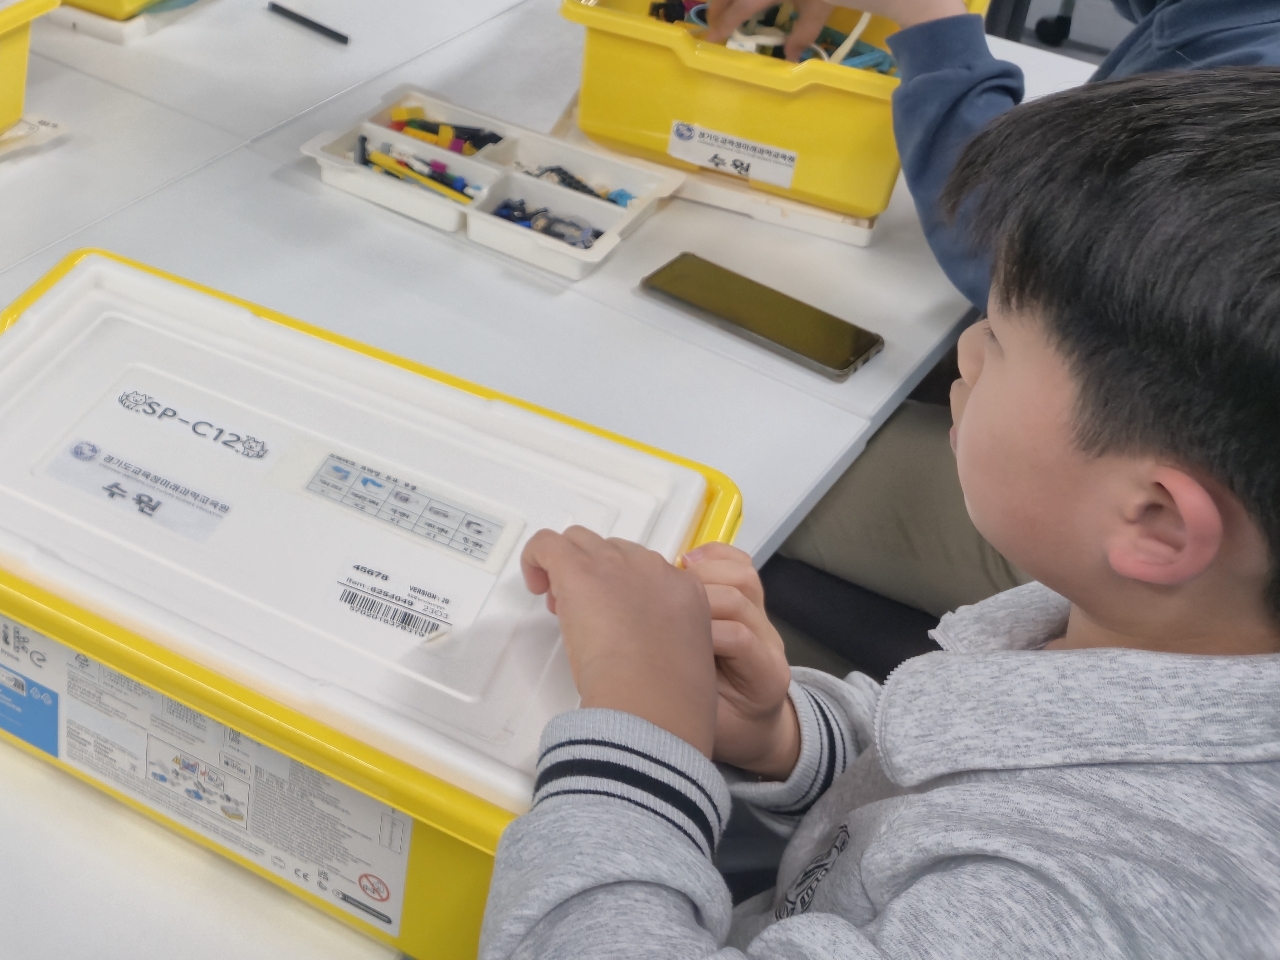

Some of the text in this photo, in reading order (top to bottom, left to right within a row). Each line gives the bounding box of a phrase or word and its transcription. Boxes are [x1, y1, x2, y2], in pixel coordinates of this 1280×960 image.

[142, 401, 241, 450] SP-C12
[102, 481, 163, 517] 수원
[353, 564, 389, 581] 45678
